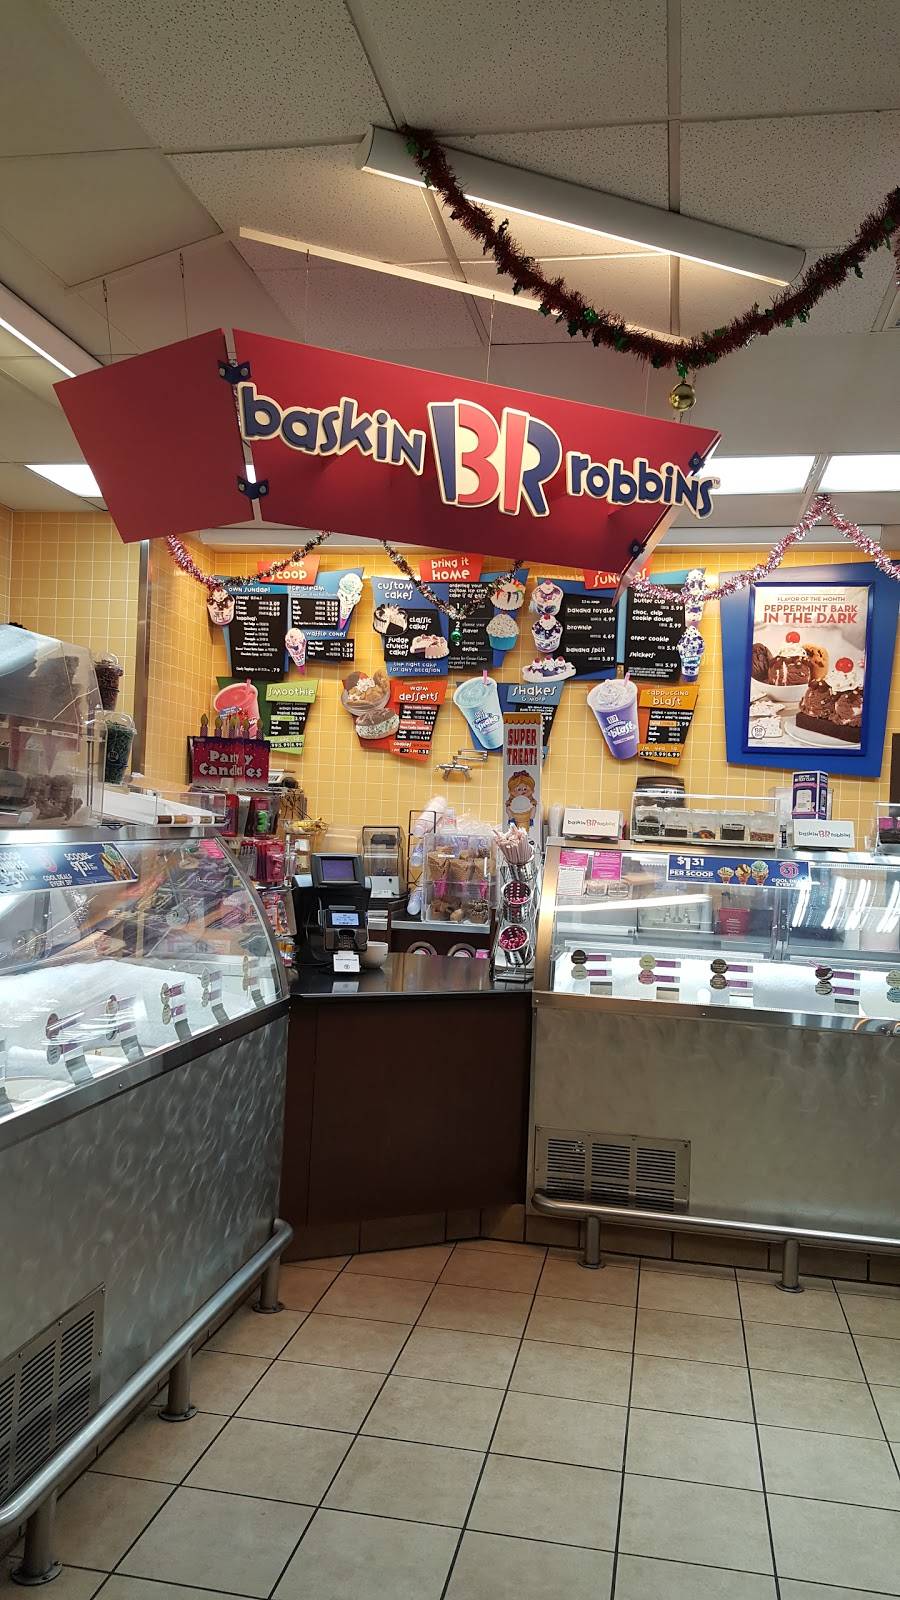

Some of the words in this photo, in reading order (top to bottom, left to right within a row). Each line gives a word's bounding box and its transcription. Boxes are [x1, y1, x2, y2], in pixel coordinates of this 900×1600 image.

[238, 382, 426, 476] baskin
[427, 399, 562, 518] BR
[566, 450, 715, 521] robbins
[431, 559, 458, 570] bring
[461, 556, 470, 567] it
[377, 582, 414, 592] custom
[385, 591, 414, 601] cakes
[764, 604, 829, 613] PEPPERMINT
[829, 604, 859, 613] BARK
[409, 616, 432, 625] classic
[763, 613, 780, 624] IN
[783, 613, 813, 624] THE
[816, 613, 859, 624] DARK
[409, 624, 430, 632] cakes
[306, 630, 327, 638] waffle
[388, 636, 410, 645] fudge
[388, 649, 409, 657] cakes
[267, 686, 317, 698] smoothie
[511, 684, 558, 697] shakes
[399, 692, 439, 702] desserts
[652, 696, 681, 707] blast
[507, 728, 537, 746] SUPER
[506, 747, 538, 766] TREAT!
[818, 830, 830, 838] BR
[669, 870, 689, 878] PER
[690, 870, 714, 880] SCOOP
